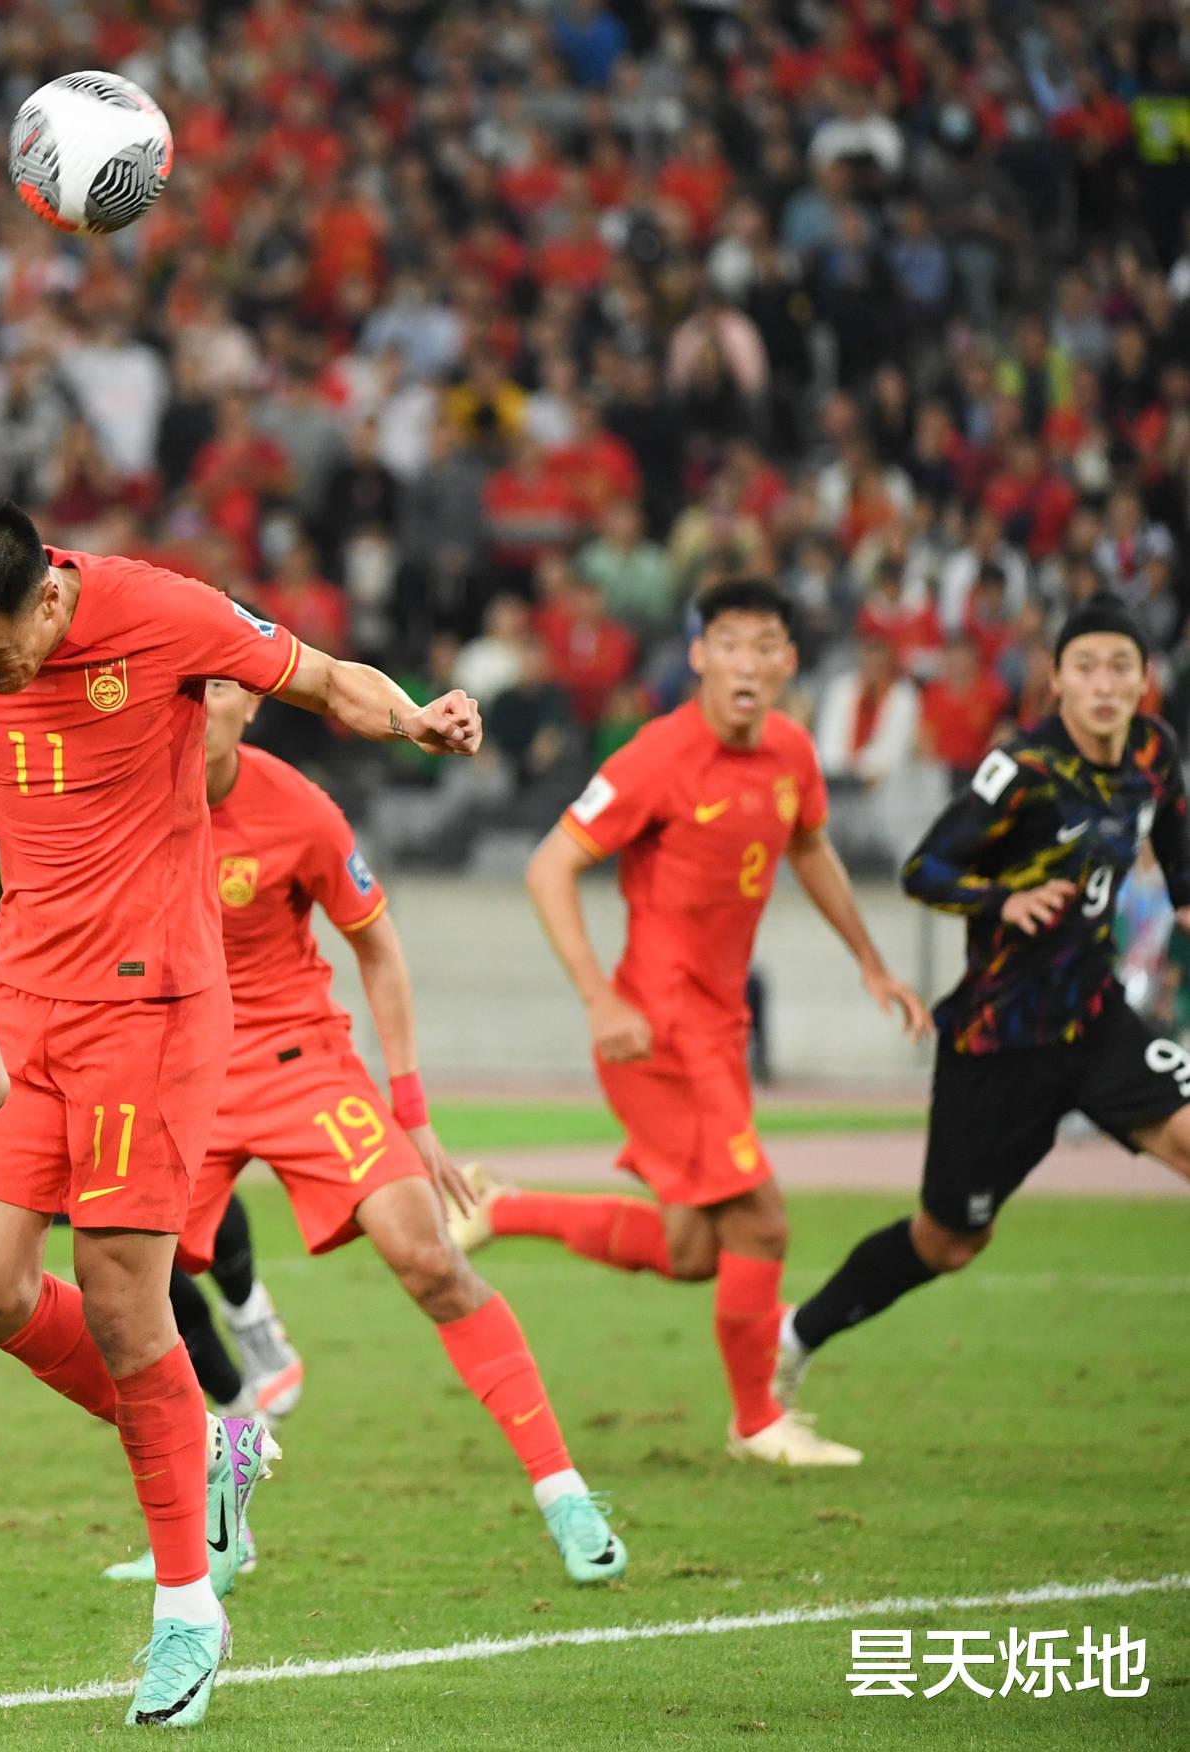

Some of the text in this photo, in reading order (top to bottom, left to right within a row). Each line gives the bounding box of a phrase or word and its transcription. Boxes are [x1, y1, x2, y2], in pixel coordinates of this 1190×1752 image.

[7, 730, 65, 794] 11
[738, 840, 768, 900] 2
[1081, 864, 1115, 918] 9
[93, 1103, 136, 1177] 11
[313, 1095, 385, 1161] 19
